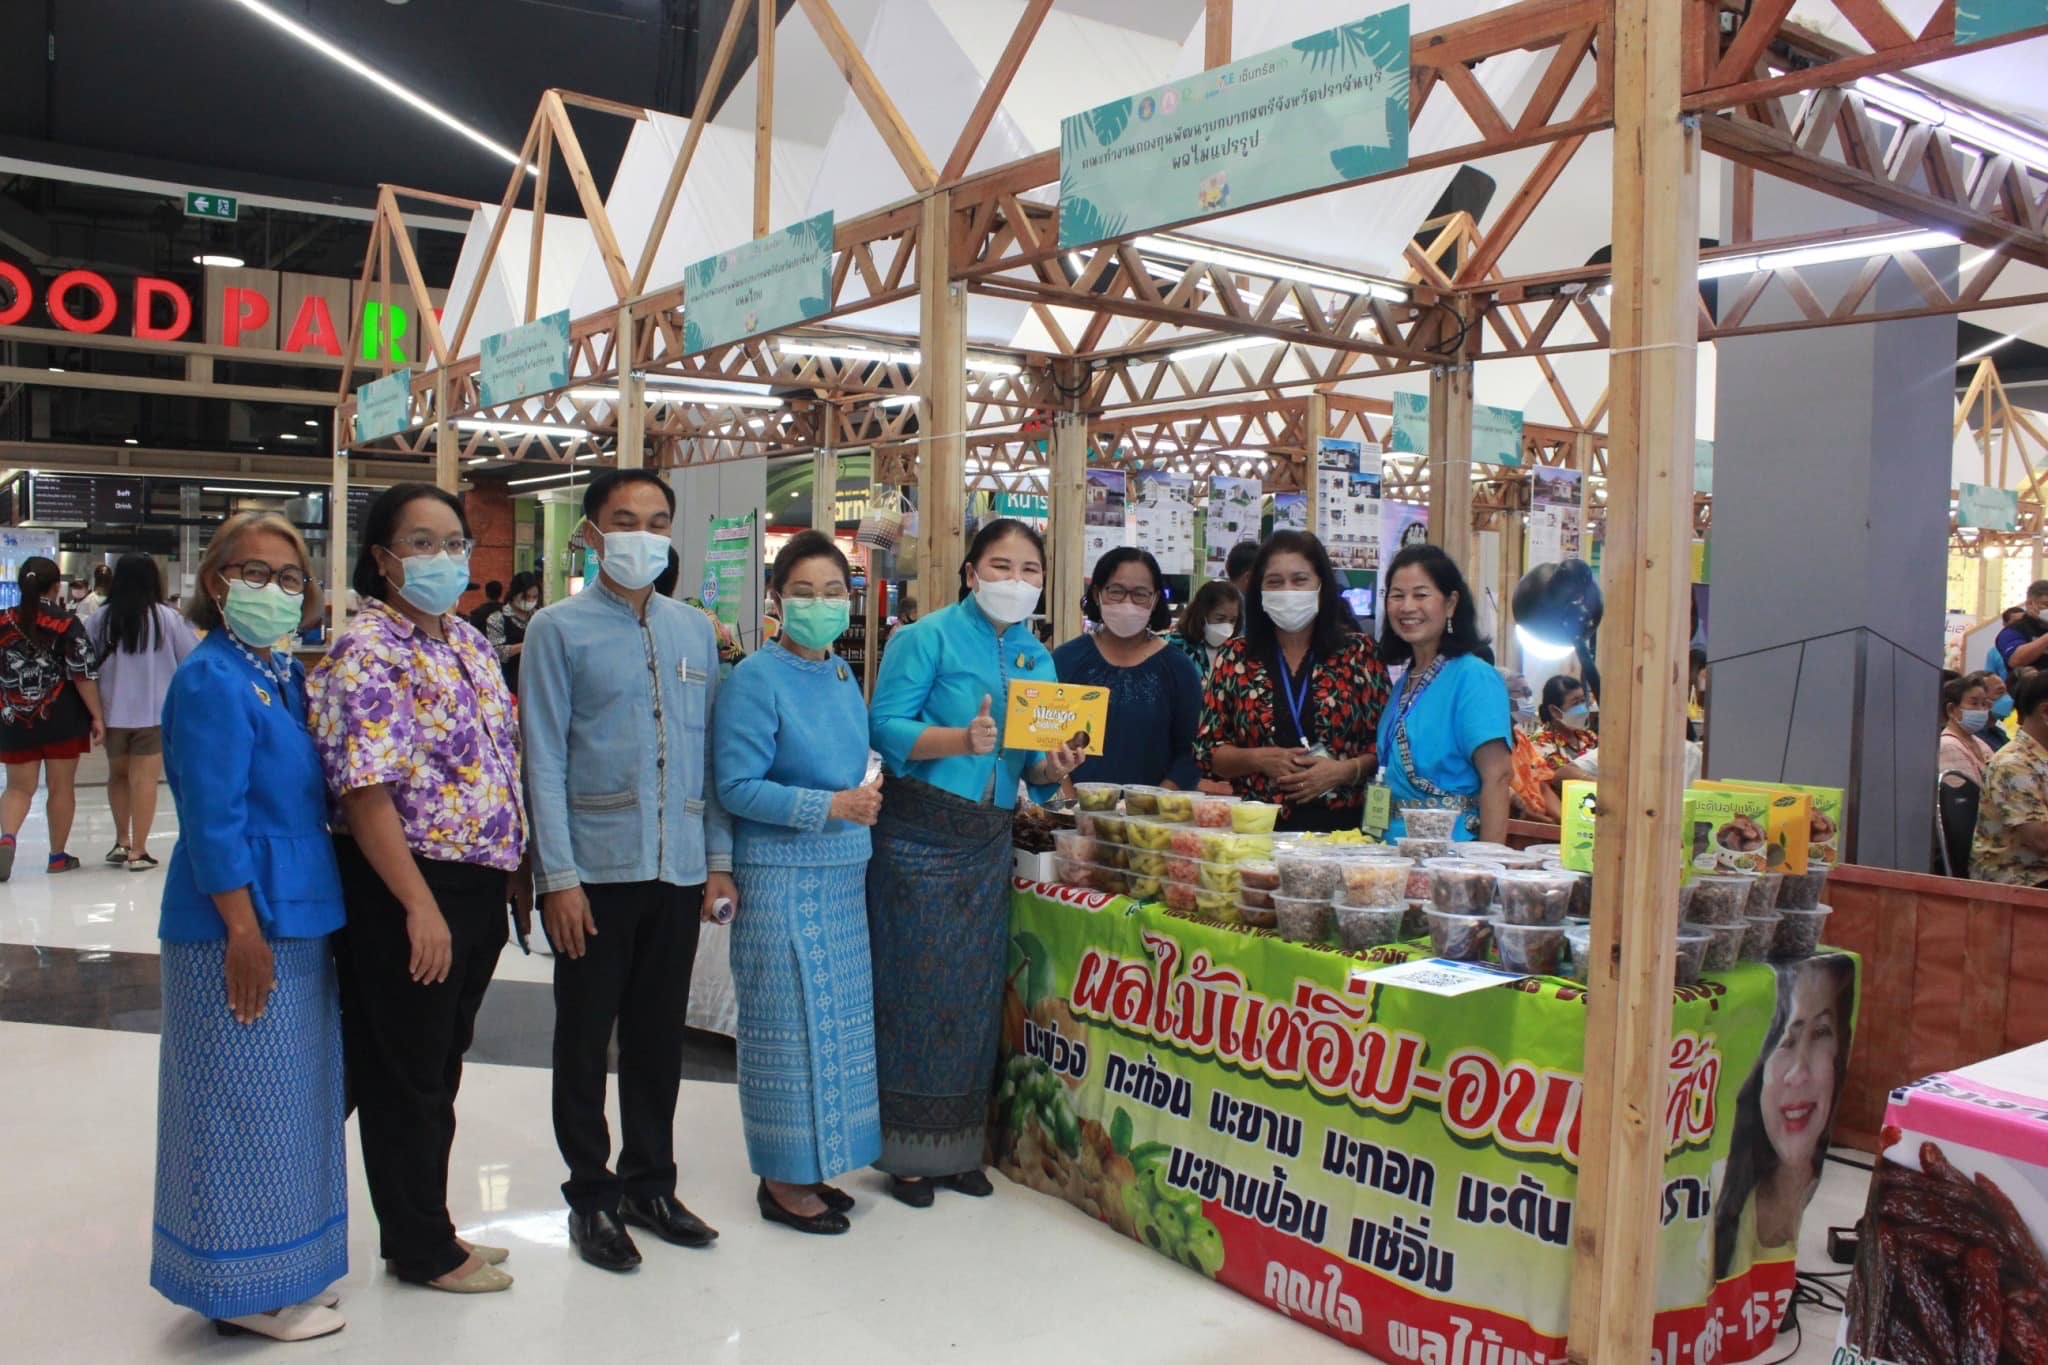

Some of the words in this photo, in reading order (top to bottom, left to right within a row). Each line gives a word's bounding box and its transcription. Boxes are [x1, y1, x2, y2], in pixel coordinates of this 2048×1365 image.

[222, 286, 443, 362] PAR
[1025, 1021, 1087, 1078] มะม่วง
[1104, 1053, 1192, 1118] กะท้อน
[1209, 1091, 1302, 1158] มะขาม
[1322, 1130, 1435, 1207] มะกอก
[1457, 1174, 1571, 1246] มะดัน
[1167, 1147, 1328, 1244] มะขามป้อม
[1347, 1216, 1454, 1292] แช่อิ่ม
[1264, 1260, 1364, 1335] คุณใจ
